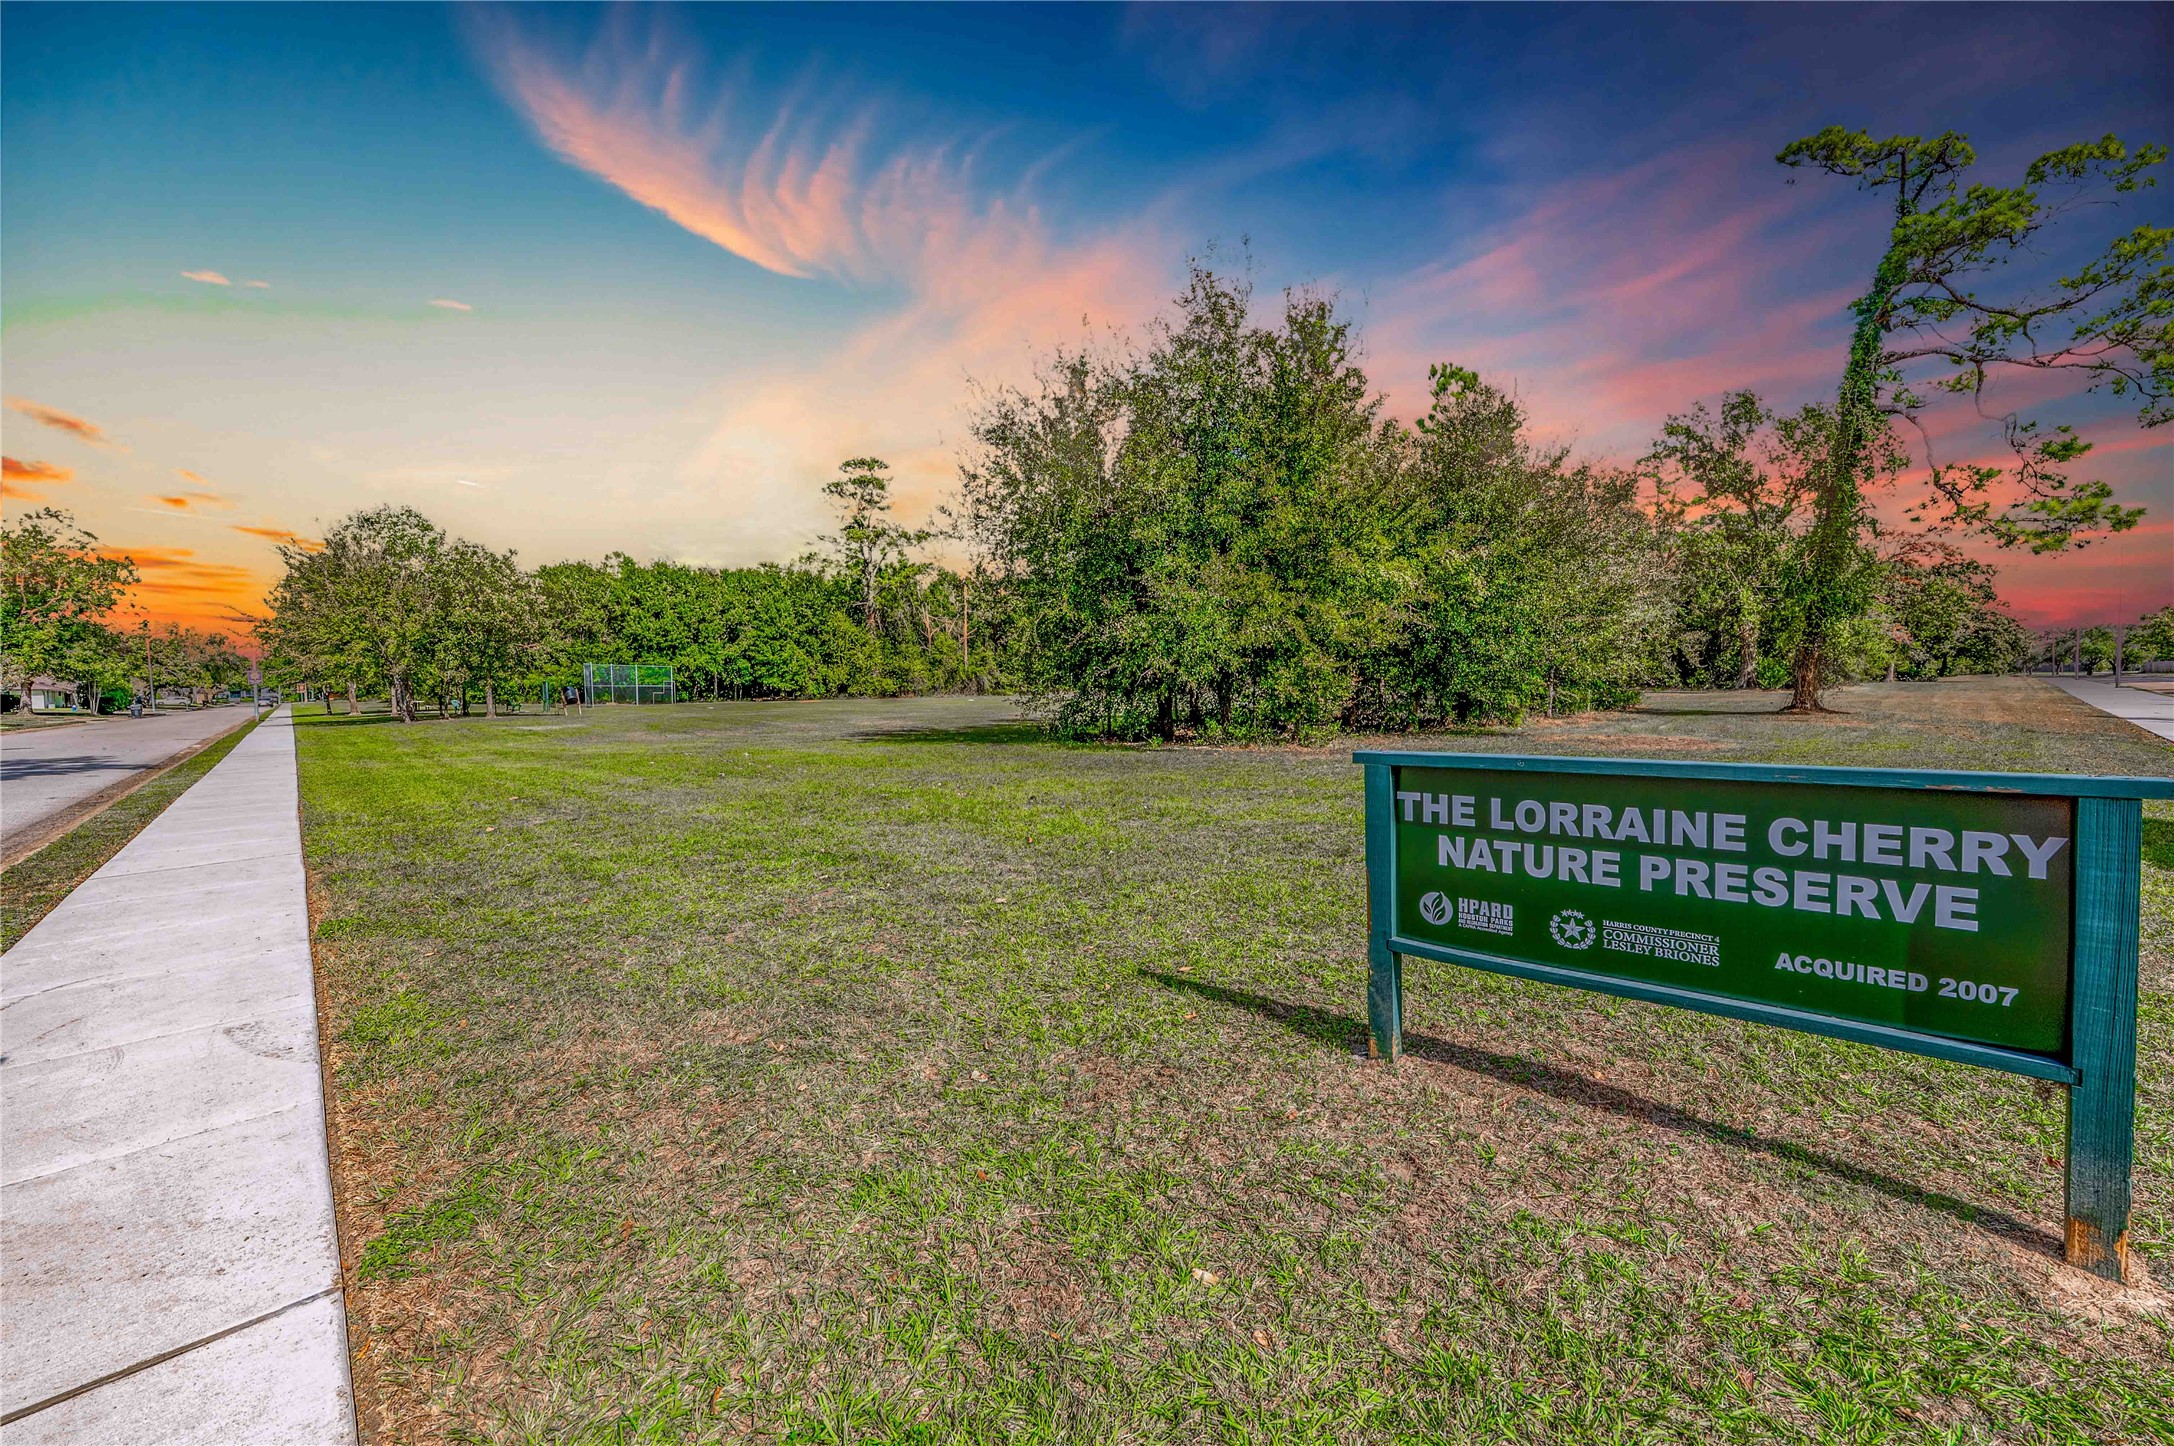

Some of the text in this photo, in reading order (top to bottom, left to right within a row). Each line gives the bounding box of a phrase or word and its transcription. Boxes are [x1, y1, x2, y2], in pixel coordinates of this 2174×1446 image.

[1397, 791, 2069, 880] THE LORRAINE CHERRY
[1438, 835, 1979, 932] NATURE PRESERVE
[1458, 897, 1513, 920] HPARD
[1458, 912, 1513, 927] HOUSTON PARKS
[1603, 919, 1632, 930] HARRIS
[1633, 924, 1669, 935] COUNTY
[1669, 929, 1714, 941] PRECINCT
[1603, 929, 1720, 957] COMMISSIONER
[1603, 939, 1720, 967] LESLEY BRIONES
[1774, 952, 2020, 1007] ACQUIRED 2007
